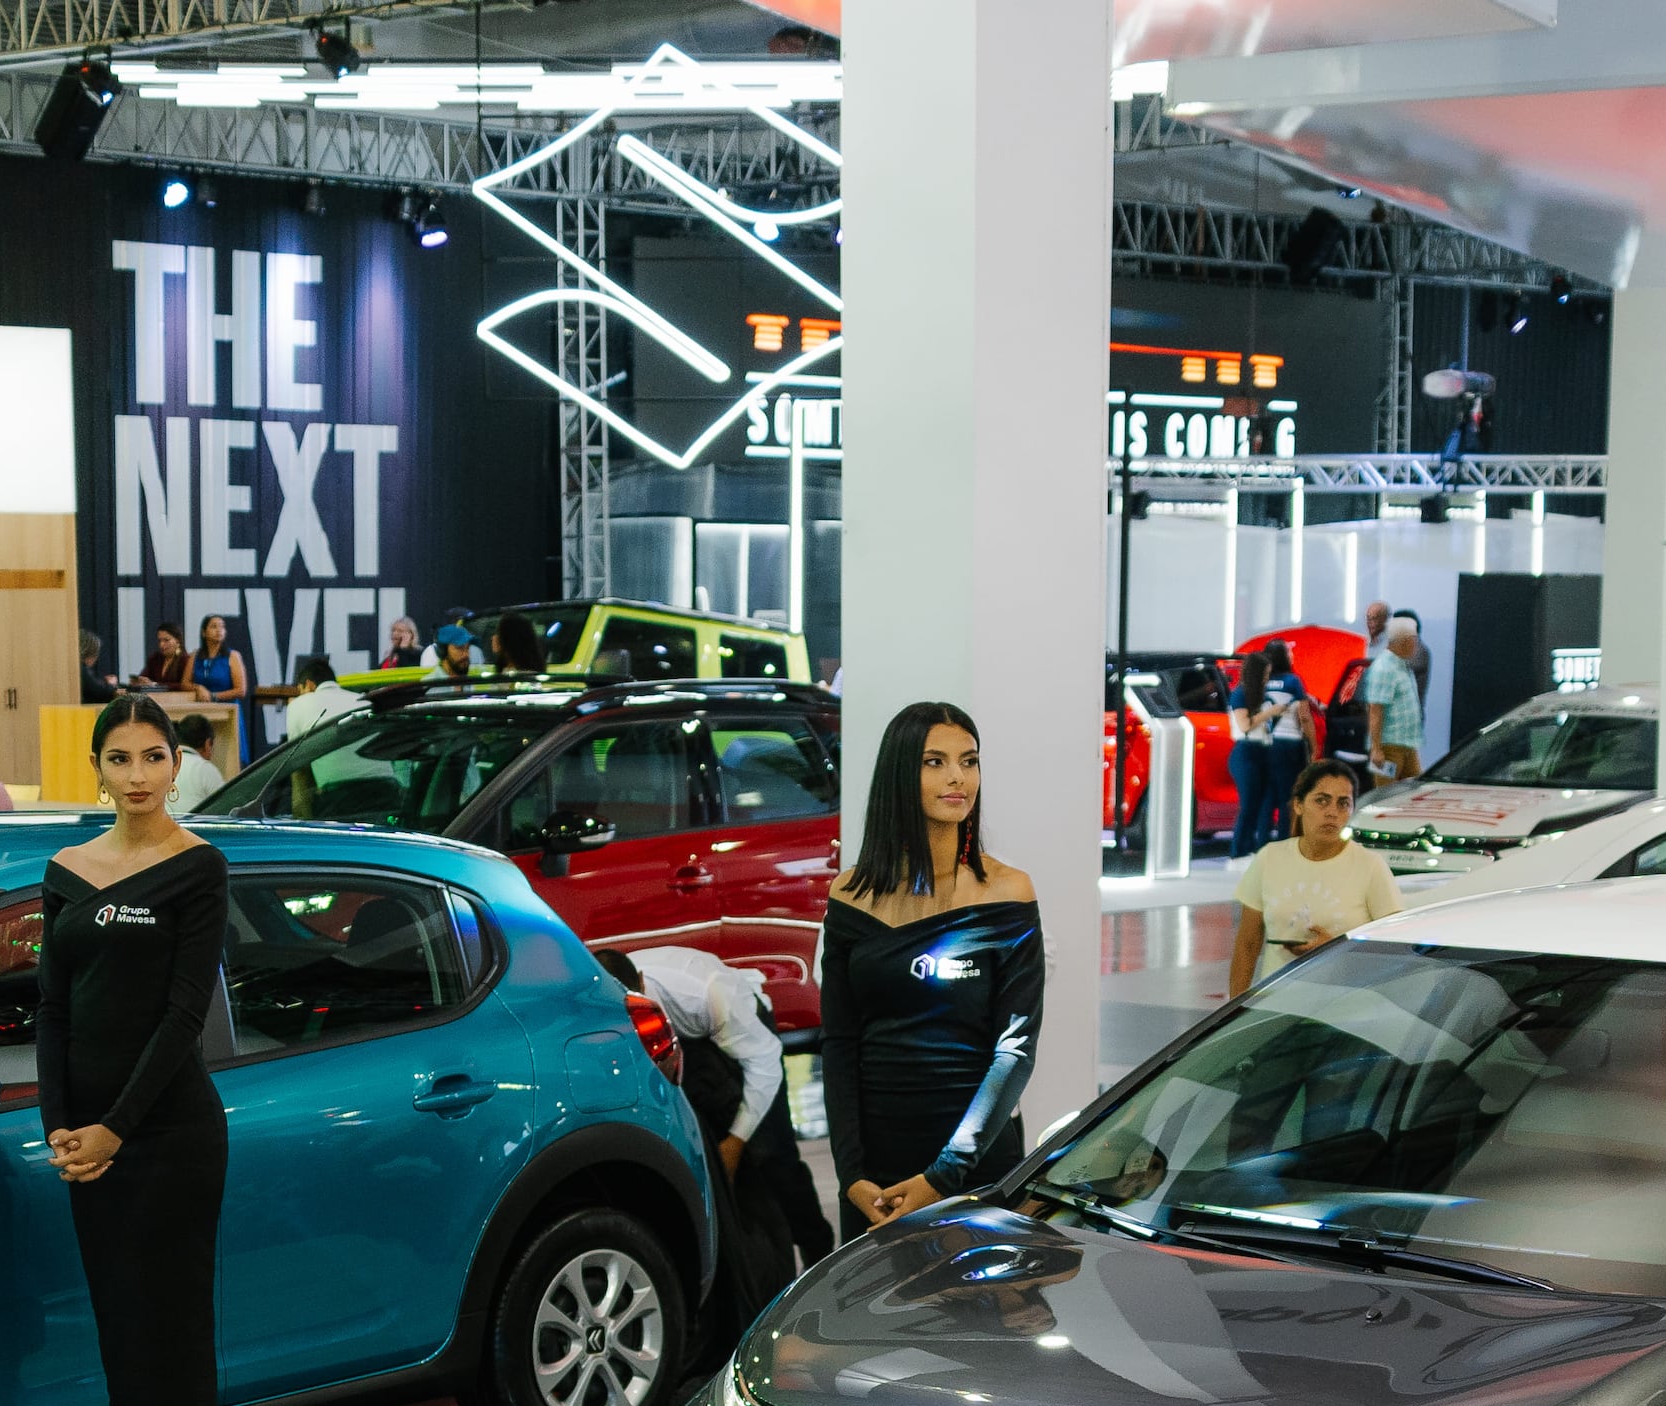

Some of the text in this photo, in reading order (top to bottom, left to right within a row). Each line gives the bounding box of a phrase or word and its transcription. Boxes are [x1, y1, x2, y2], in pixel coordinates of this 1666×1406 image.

[112, 240, 323, 411] THE
[1112, 410, 1148, 458] IS
[115, 415, 399, 577] NEXT
[116, 914, 156, 924] Mavesa
[119, 905, 150, 916] Grupo
